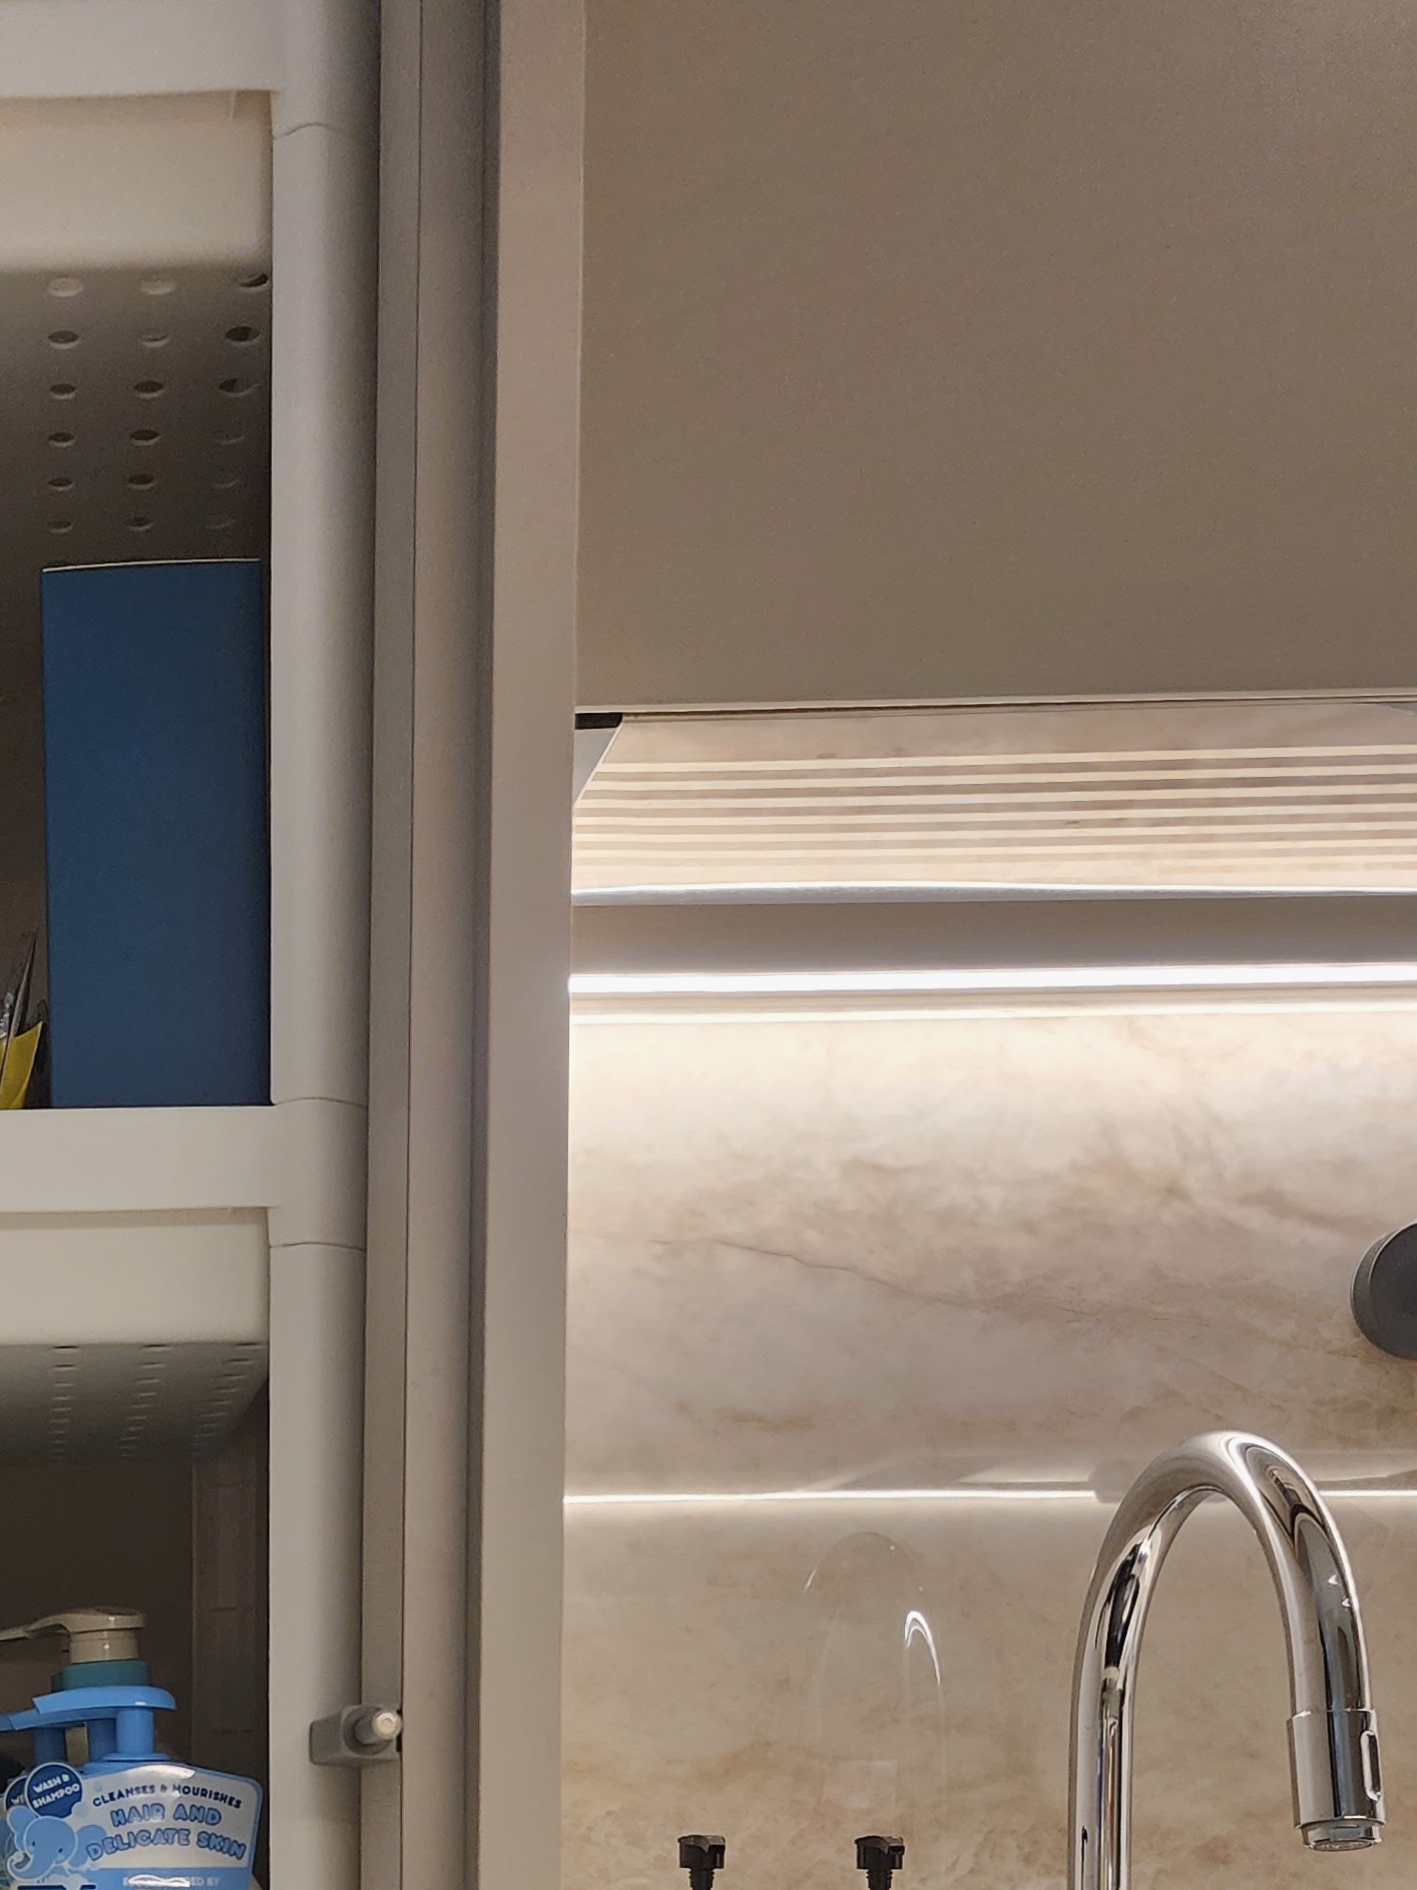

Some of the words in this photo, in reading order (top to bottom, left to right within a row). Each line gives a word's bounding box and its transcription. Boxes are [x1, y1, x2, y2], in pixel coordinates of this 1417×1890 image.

[32, 1776, 62, 1794] WASH
[32, 1782, 80, 1809] SHAMPOO
[92, 1784, 156, 1807] CLEANSES
[172, 1783, 243, 1809] NOURISHES
[109, 1802, 166, 1828] HAIR
[172, 1802, 223, 1827] AND
[86, 1827, 191, 1862] DELICATE
[196, 1830, 247, 1861] SKIN
